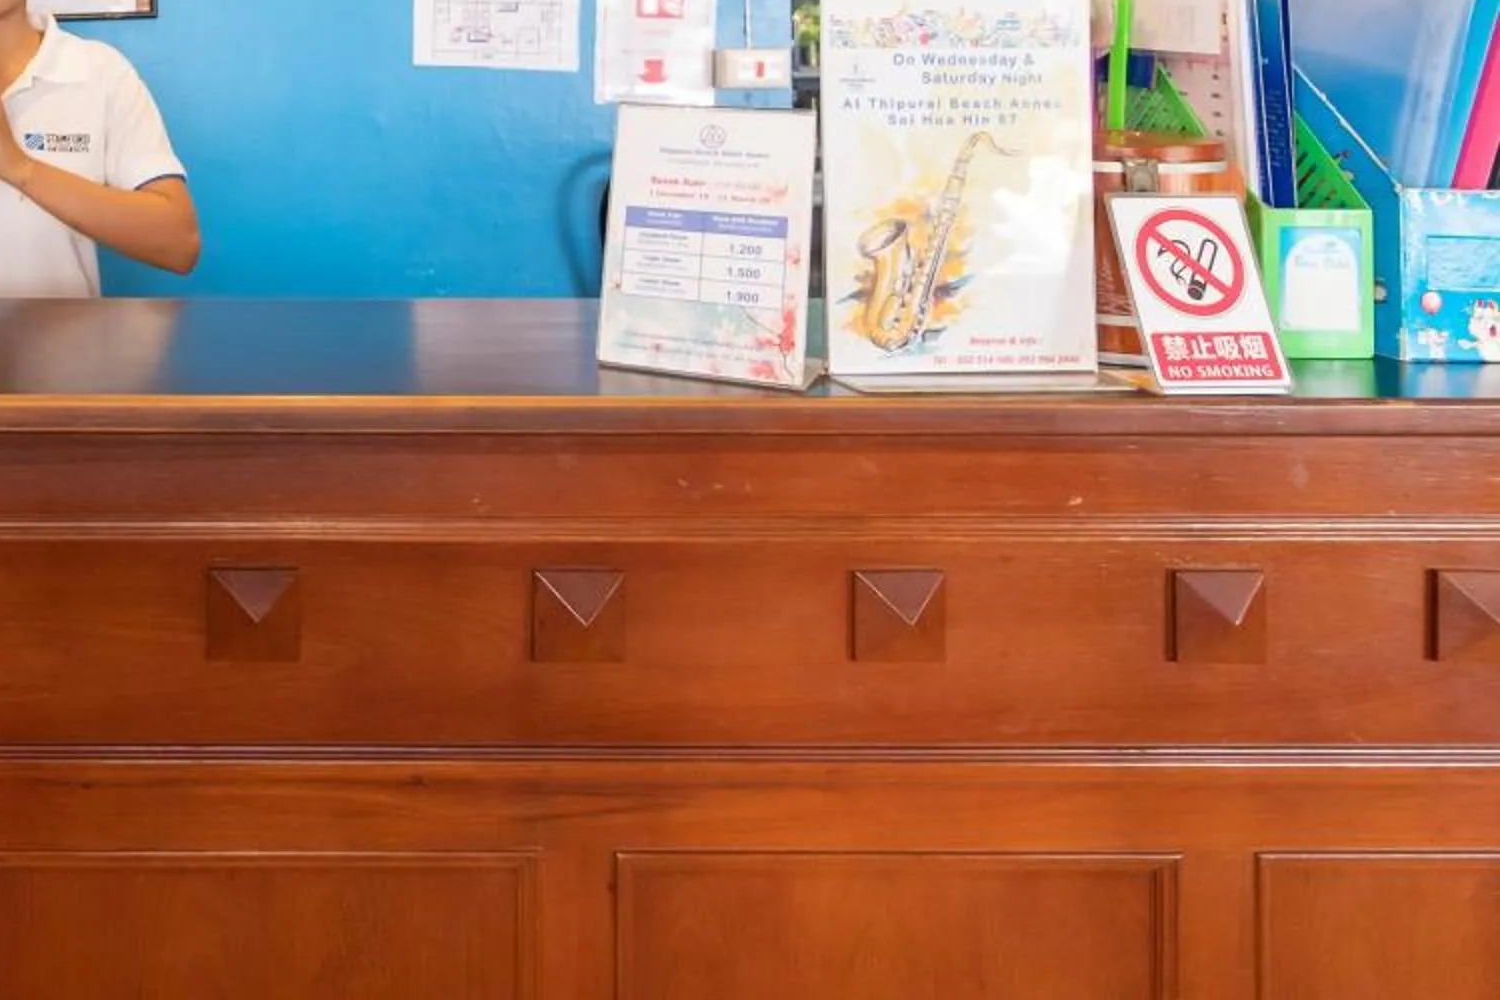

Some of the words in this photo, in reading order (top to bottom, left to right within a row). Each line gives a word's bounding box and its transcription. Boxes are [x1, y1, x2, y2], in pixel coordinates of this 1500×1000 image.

[893, 52, 915, 66] On
[922, 52, 1017, 69] Wednesday
[1023, 53, 1035, 66] &
[922, 71, 997, 87] Saturday
[1002, 73, 1043, 88] Night
[843, 97, 861, 110] At
[949, 97, 1001, 110] Beach
[1161, 334, 1269, 361] 禁止吸烟
[1167, 365, 1193, 378] NO
[1196, 365, 1275, 378] SMOKING
